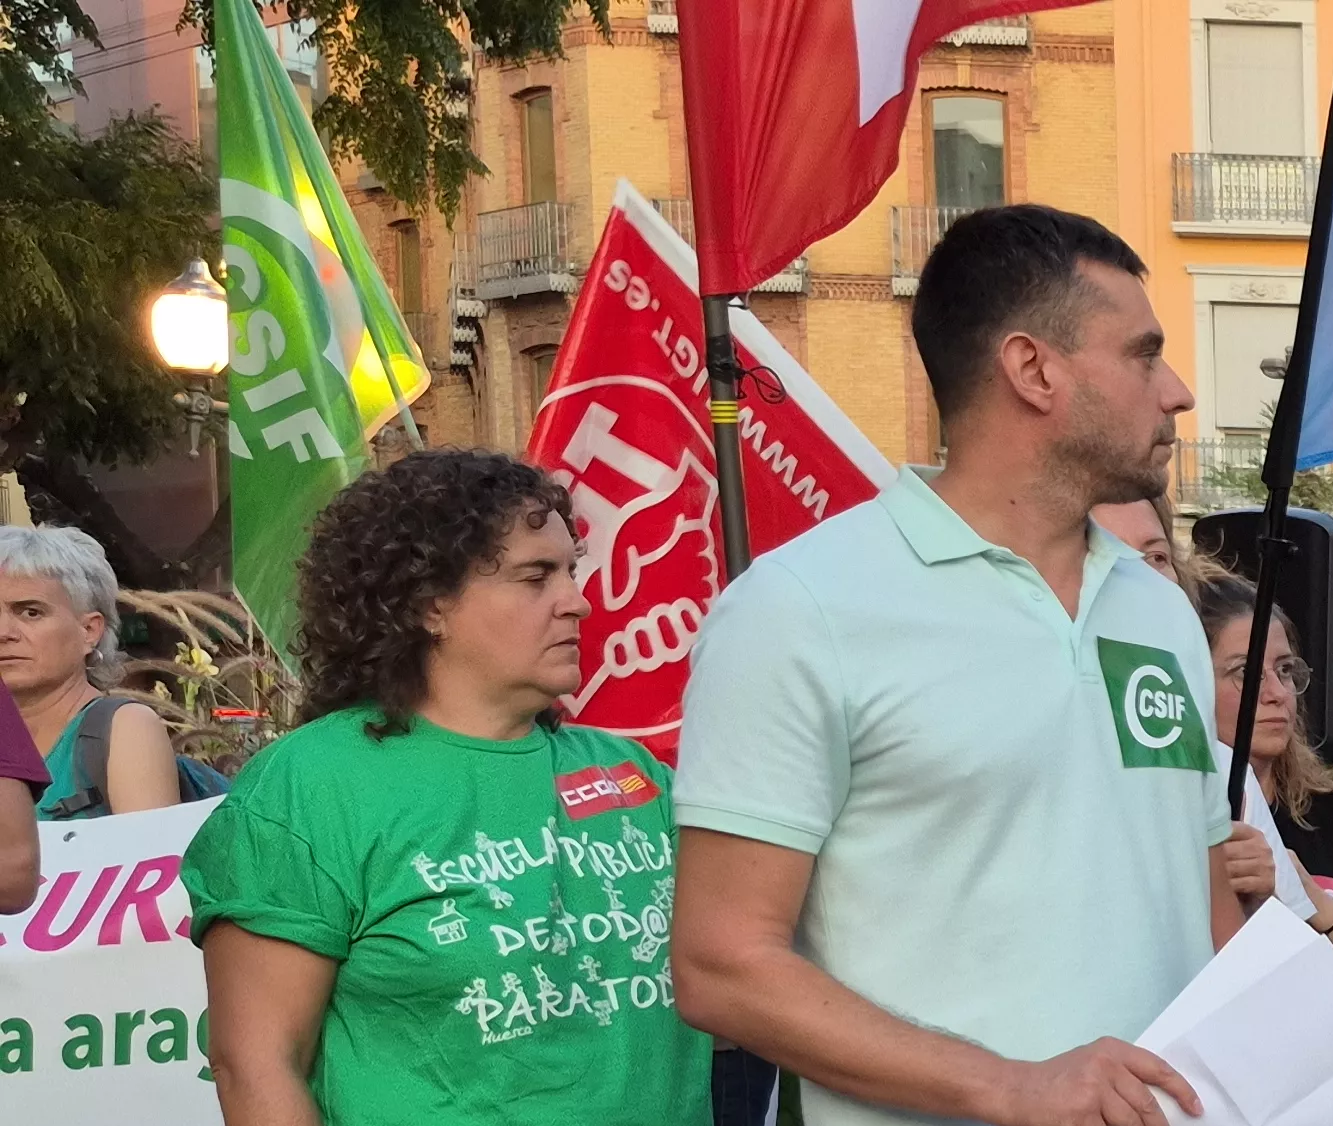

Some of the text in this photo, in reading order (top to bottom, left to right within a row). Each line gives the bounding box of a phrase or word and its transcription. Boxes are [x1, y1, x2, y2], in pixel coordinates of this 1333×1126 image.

[1139, 688, 1186, 721] CSIF
[561, 779, 623, 807] CCOO
[420, 827, 560, 893] ESCUELA
[0, 854, 193, 952] UR
[490, 916, 550, 957] DE
[476, 983, 594, 1032] PARA
